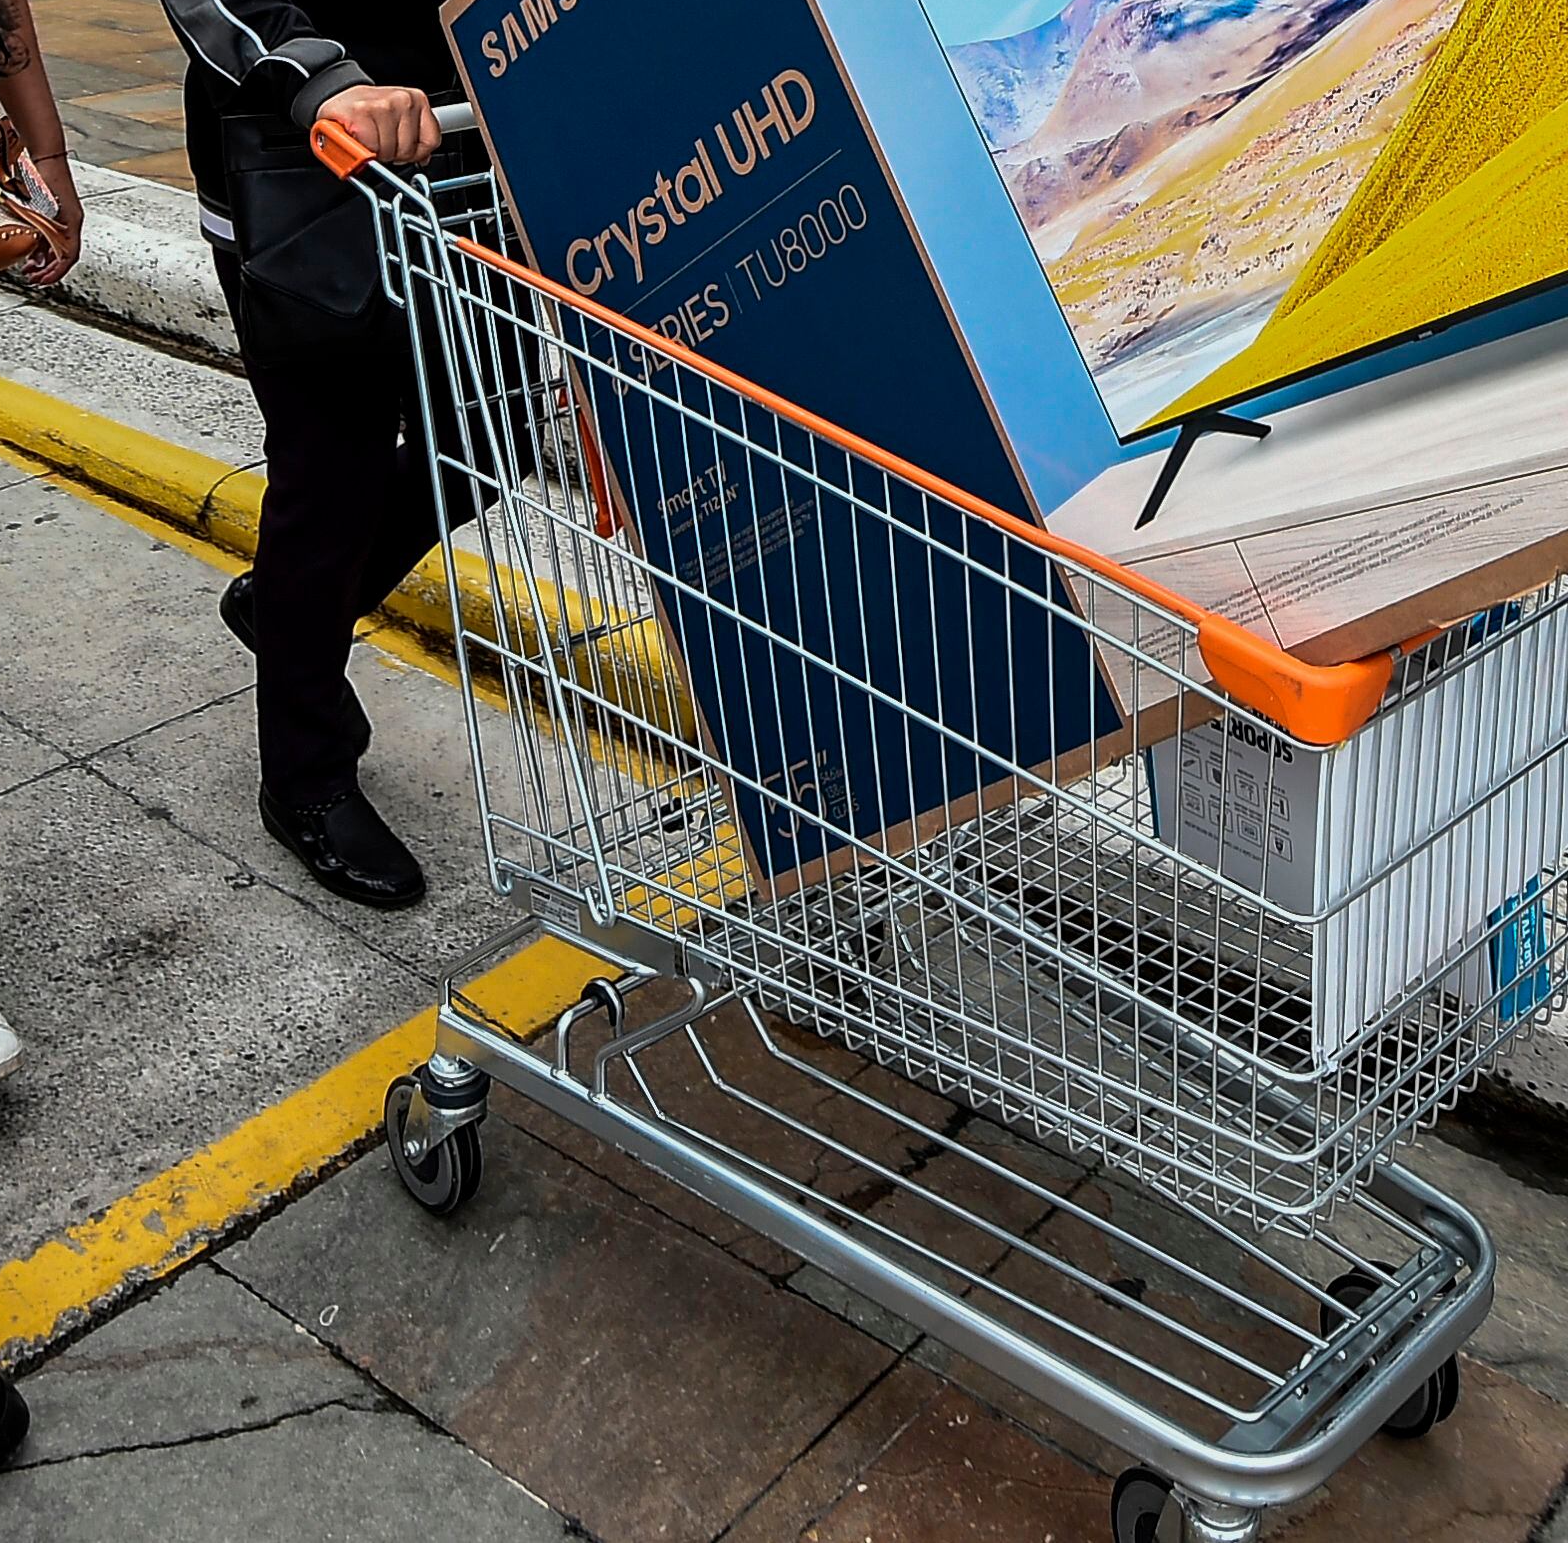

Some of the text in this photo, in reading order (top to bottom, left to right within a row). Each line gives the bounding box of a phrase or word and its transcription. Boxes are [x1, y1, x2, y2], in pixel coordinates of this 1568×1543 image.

[566, 69, 816, 296] Crystal UHD
[735, 184, 867, 301] TU8000
[700, 486, 737, 517] TIZN
